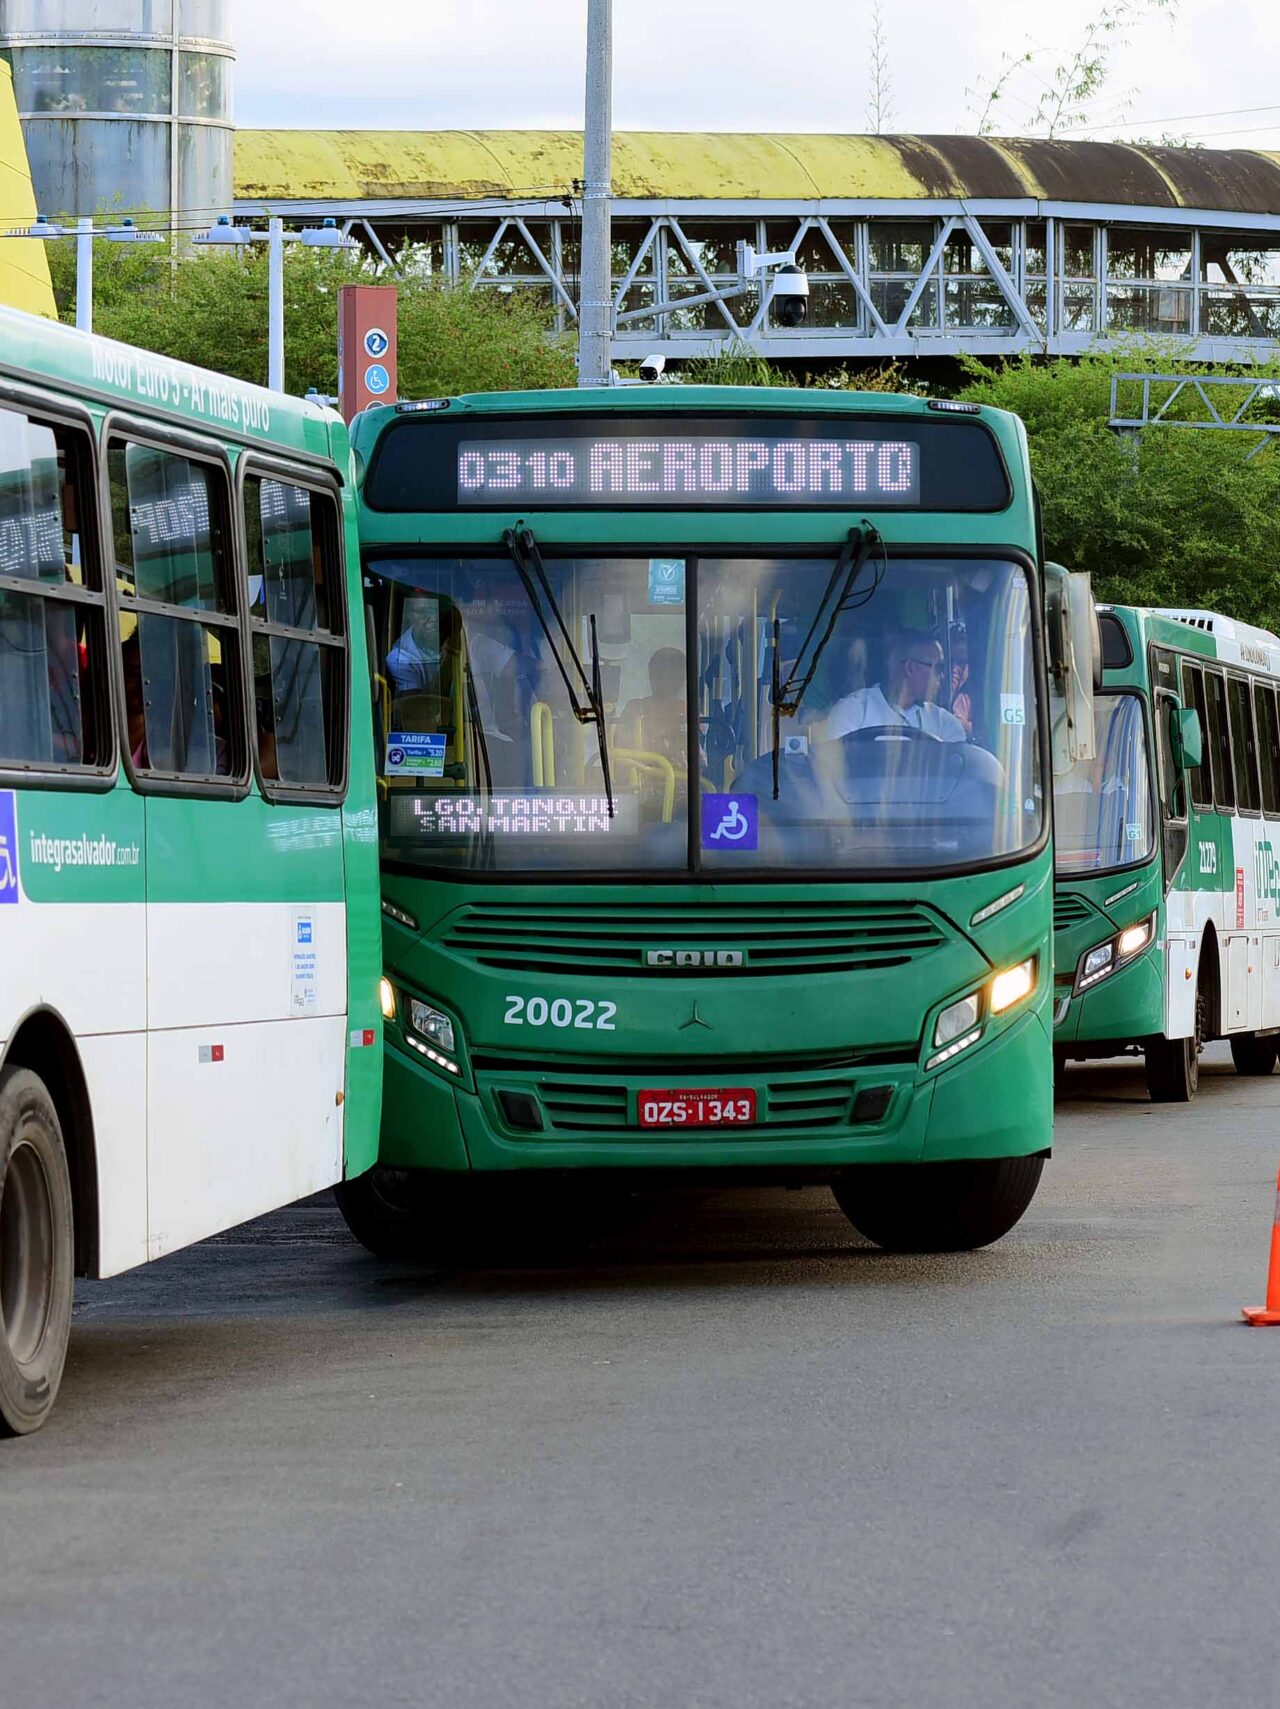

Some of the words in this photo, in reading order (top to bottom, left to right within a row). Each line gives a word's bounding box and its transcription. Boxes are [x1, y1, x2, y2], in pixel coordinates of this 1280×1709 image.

[371, 335, 381, 351] 2
[136, 356, 169, 401] Euro
[207, 385, 239, 424] mais
[242, 398, 270, 435] puro
[459, 451, 575, 488] 0310
[589, 442, 913, 492] AEROPORTO
[1004, 708, 1024, 723] G5
[401, 734, 431, 744] TARIFA
[420, 816, 481, 833] SAN
[488, 816, 610, 833] MARTIN
[30, 829, 140, 872] integrasalvador.com.br
[504, 996, 617, 1031] 20022
